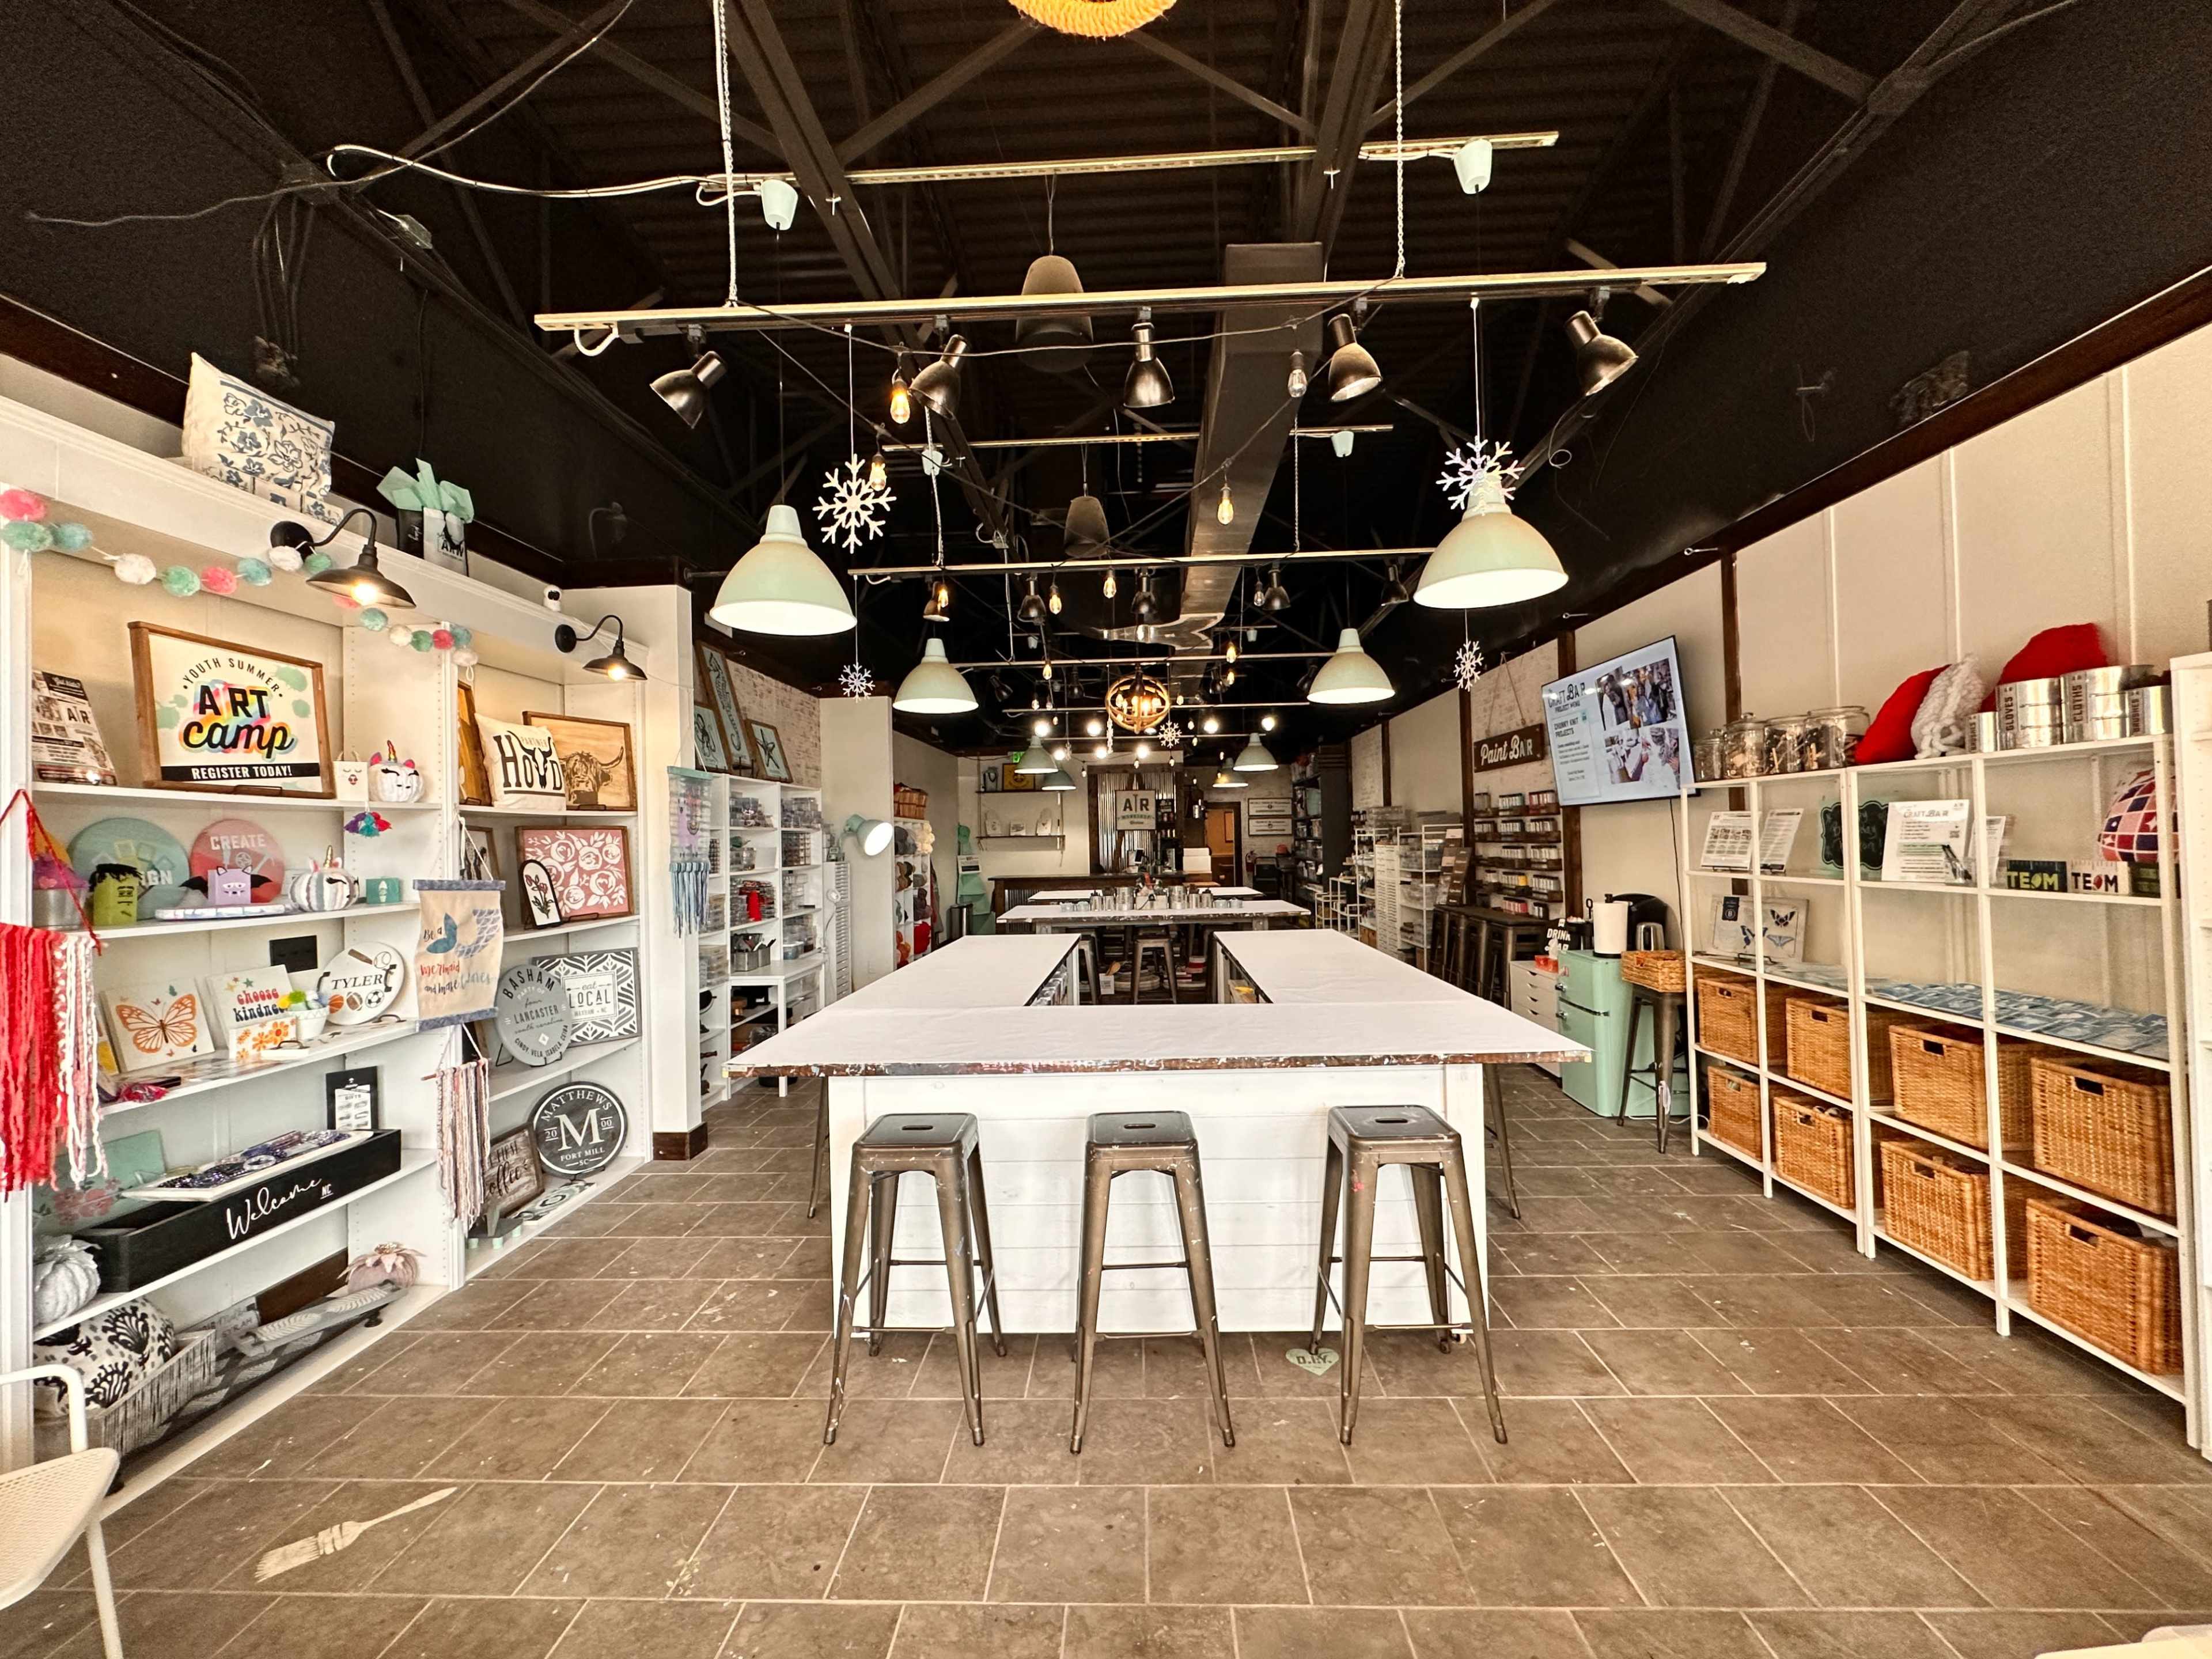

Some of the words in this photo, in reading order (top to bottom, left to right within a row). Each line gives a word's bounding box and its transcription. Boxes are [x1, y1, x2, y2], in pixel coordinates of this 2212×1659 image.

[183, 658, 221, 684] YOUTH
[228, 658, 280, 692] SUMMER
[1567, 682, 1585, 700] BAR
[199, 685, 268, 718] ART
[2073, 685, 2082, 722] CLOTHS
[2004, 696, 2014, 731] GLOVES
[183, 721, 294, 759] camp
[1480, 741, 1508, 766] Paint
[1509, 734, 1533, 760] BAR
[191, 768, 249, 779] REGISTER
[252, 765, 293, 777] TODAY!
[210, 834, 267, 850] CREATE
[141, 870, 173, 885] IGN
[1547, 928, 1571, 942] DRINK
[331, 975, 383, 990] TYLER
[502, 968, 555, 999] BASHAM
[582, 981, 597, 990] eat
[237, 988, 279, 1005] choose
[569, 989, 611, 1009] LOCAL
[233, 1002, 289, 1022] kindne
[514, 1005, 559, 1024] LANCASTER
[541, 1090, 612, 1121] MATTHEWS
[546, 1130, 558, 1138] 20
[554, 1108, 604, 1151] M
[601, 1119, 612, 1128] 00
[560, 1153, 581, 1162] FORT
[585, 1147, 605, 1156] MILL
[486, 1161, 522, 1197] offee
[226, 1178, 323, 1240] Welcome
[321, 1184, 332, 1196] NC
[1297, 1354, 1332, 1364] D.I.Y.
